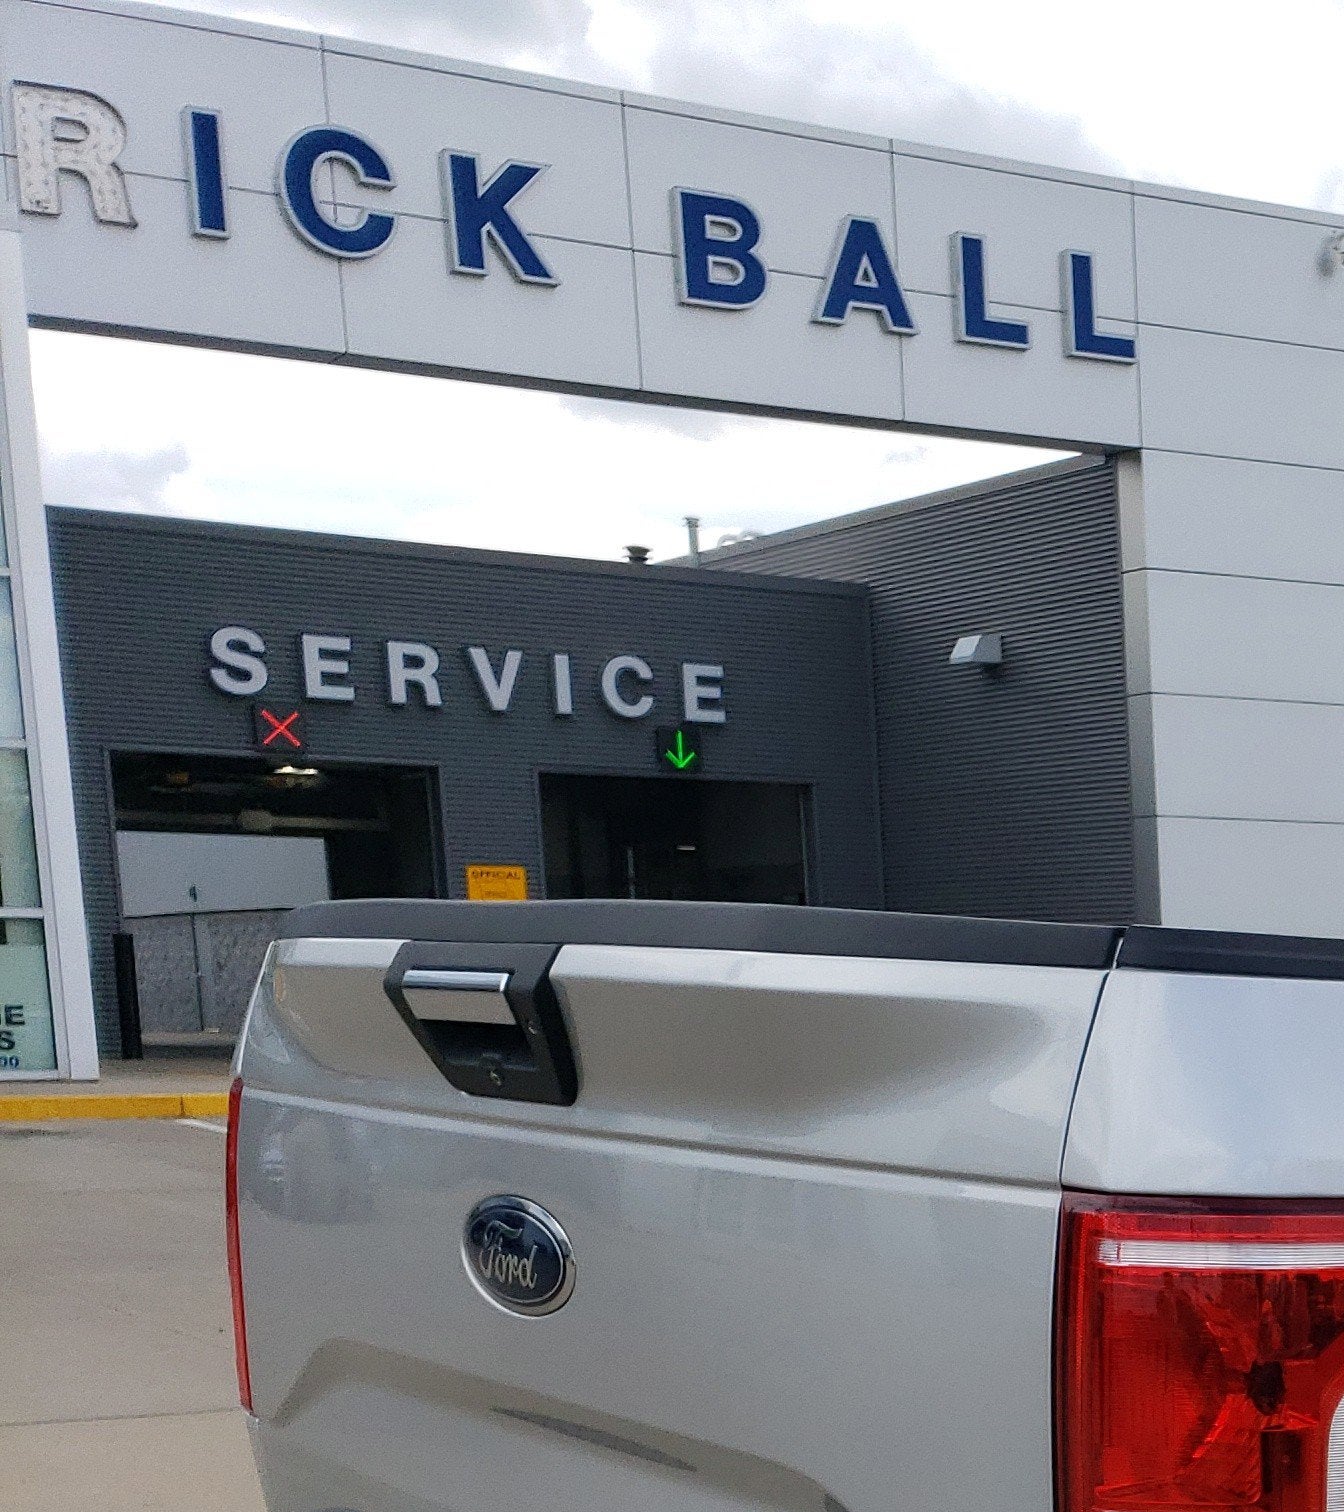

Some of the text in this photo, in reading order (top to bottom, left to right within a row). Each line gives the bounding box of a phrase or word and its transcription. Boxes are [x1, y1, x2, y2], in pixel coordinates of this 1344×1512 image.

[12, 79, 1137, 363] RICK BALL
[208, 626, 727, 724] SERVICE
[479, 1219, 538, 1290] Ford
